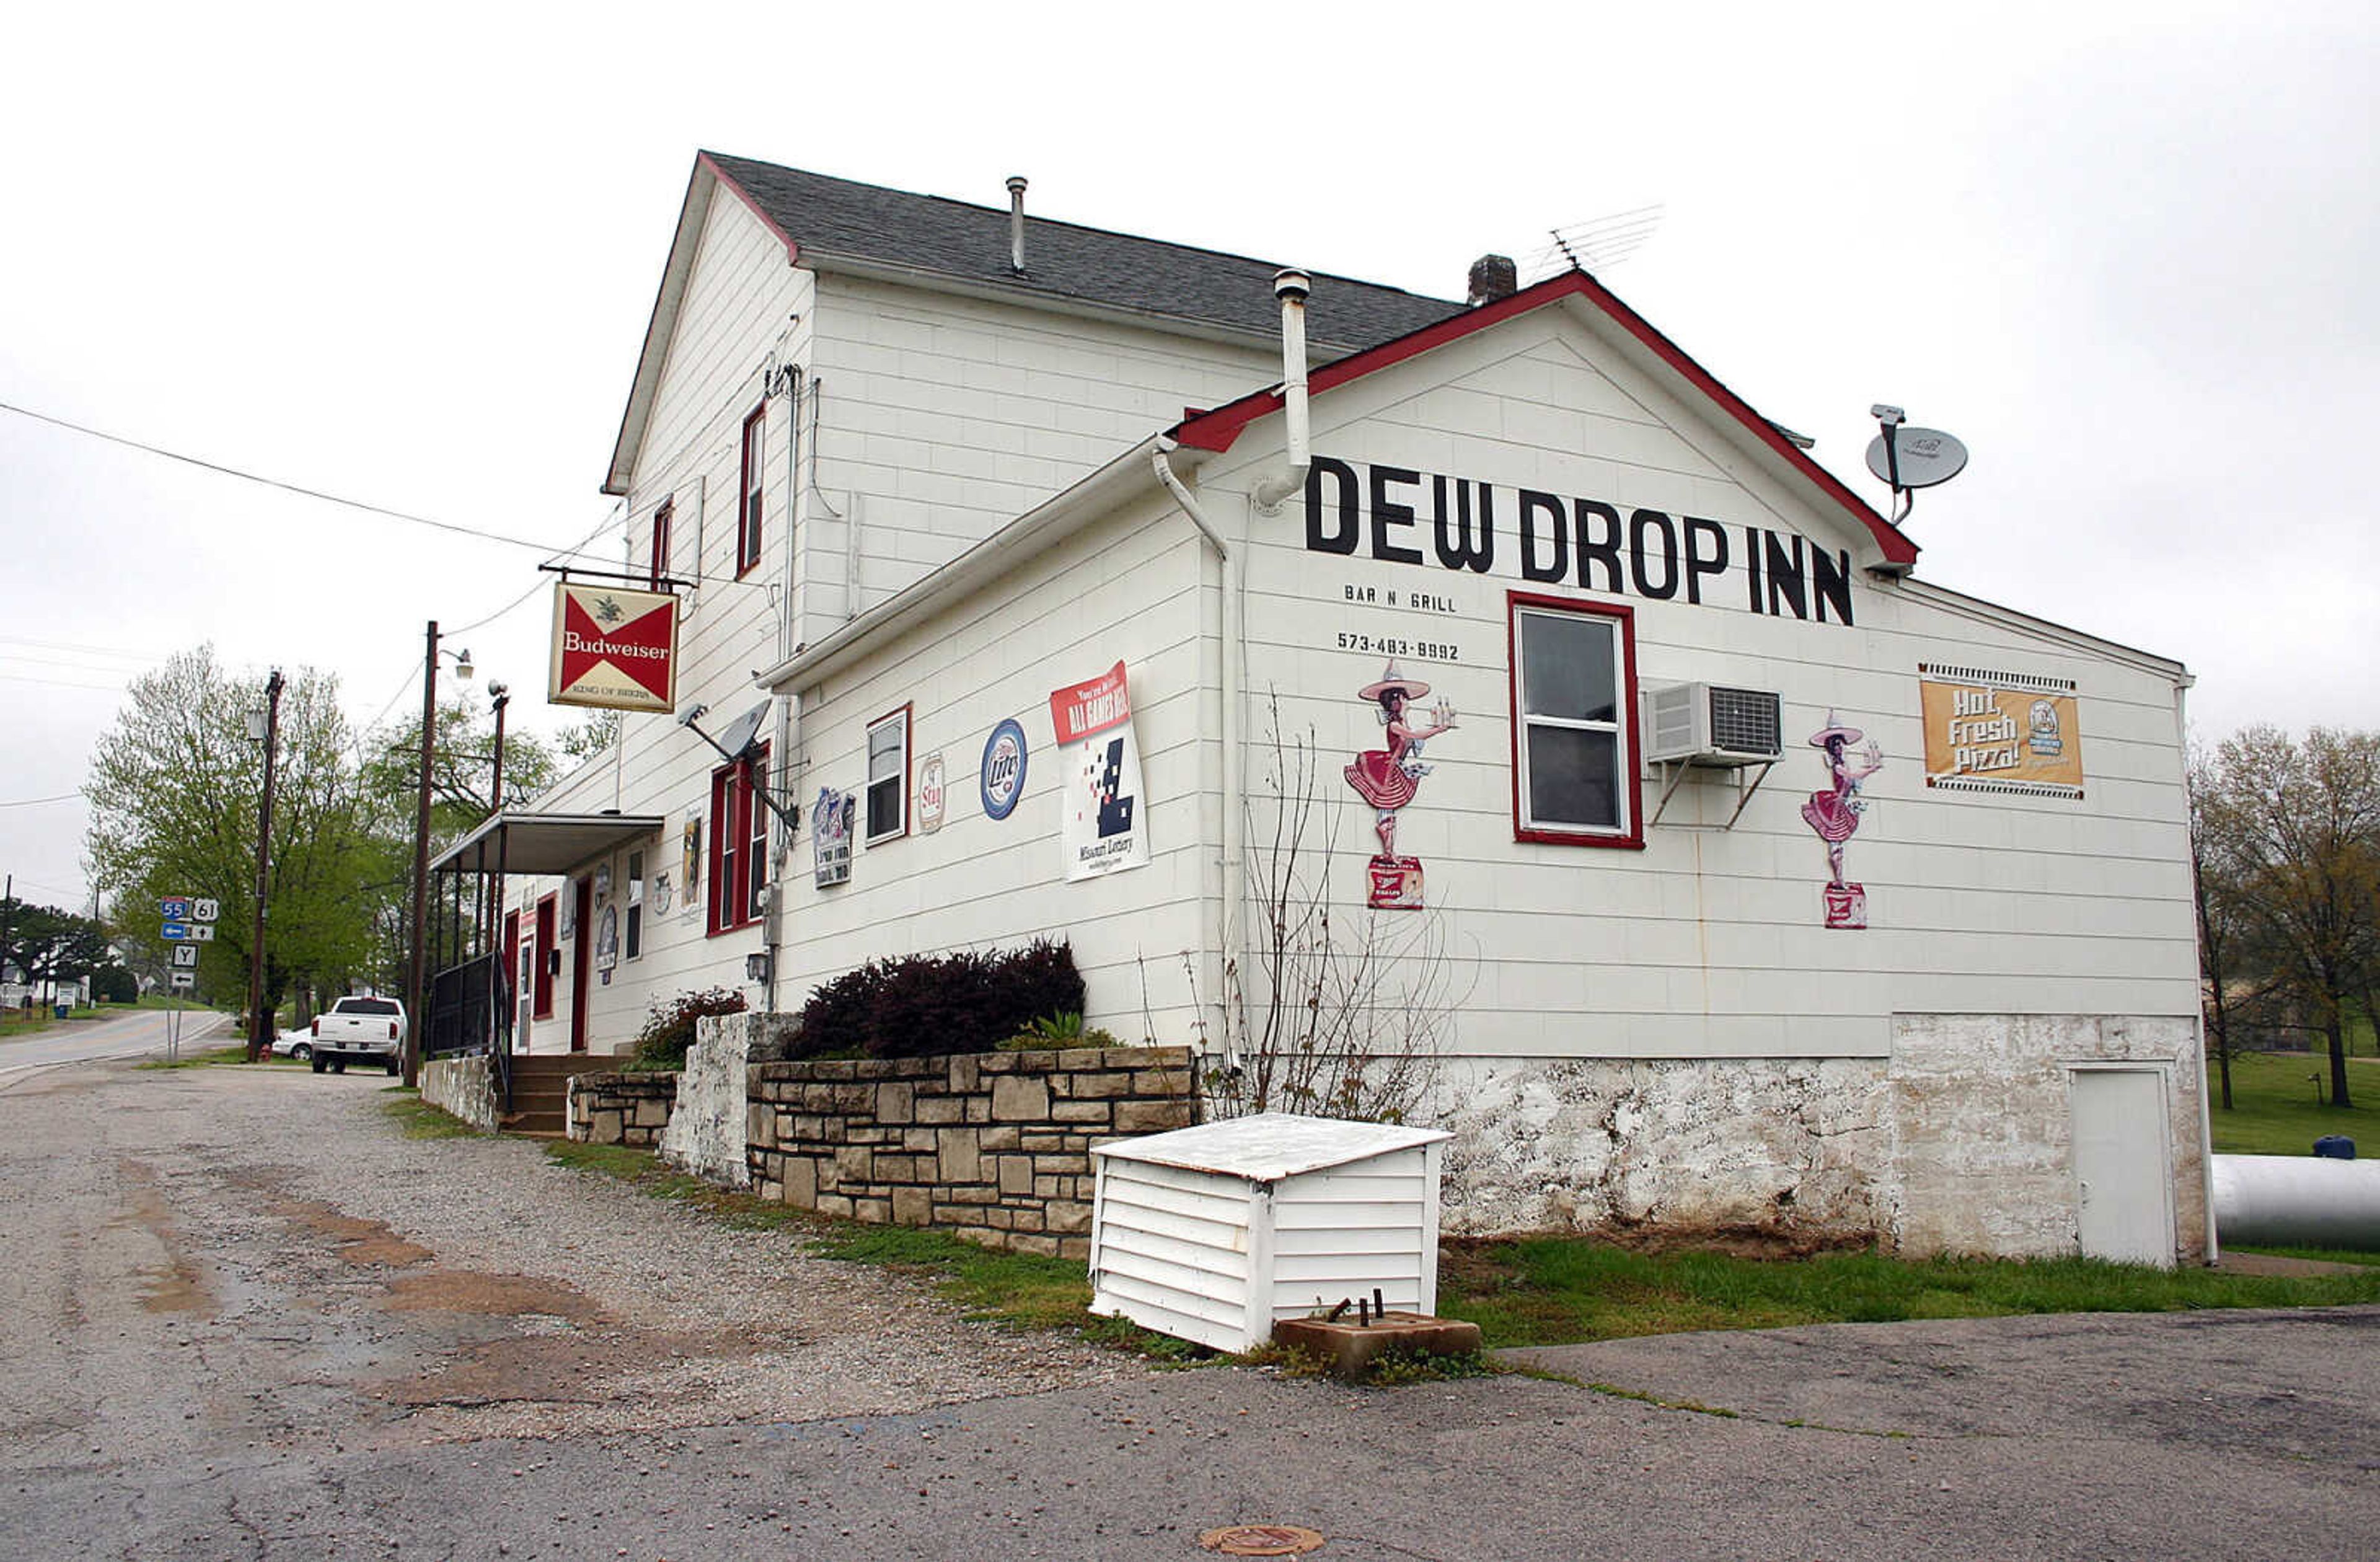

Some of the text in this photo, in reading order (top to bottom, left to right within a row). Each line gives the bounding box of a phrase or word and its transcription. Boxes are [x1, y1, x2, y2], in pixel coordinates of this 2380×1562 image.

[1305, 455, 1854, 627] DEW DROP INN
[1345, 585, 1457, 612] BAR N GRILL
[565, 630, 669, 660] Budweiser
[1953, 686, 2003, 717] Hot,
[1949, 714, 2018, 746] Fresh
[988, 754, 1018, 788] Lite
[1953, 741, 2021, 775] Pizza!
[162, 904, 183, 917] 55
[198, 904, 214, 917] 61
[179, 948, 192, 962] Y
